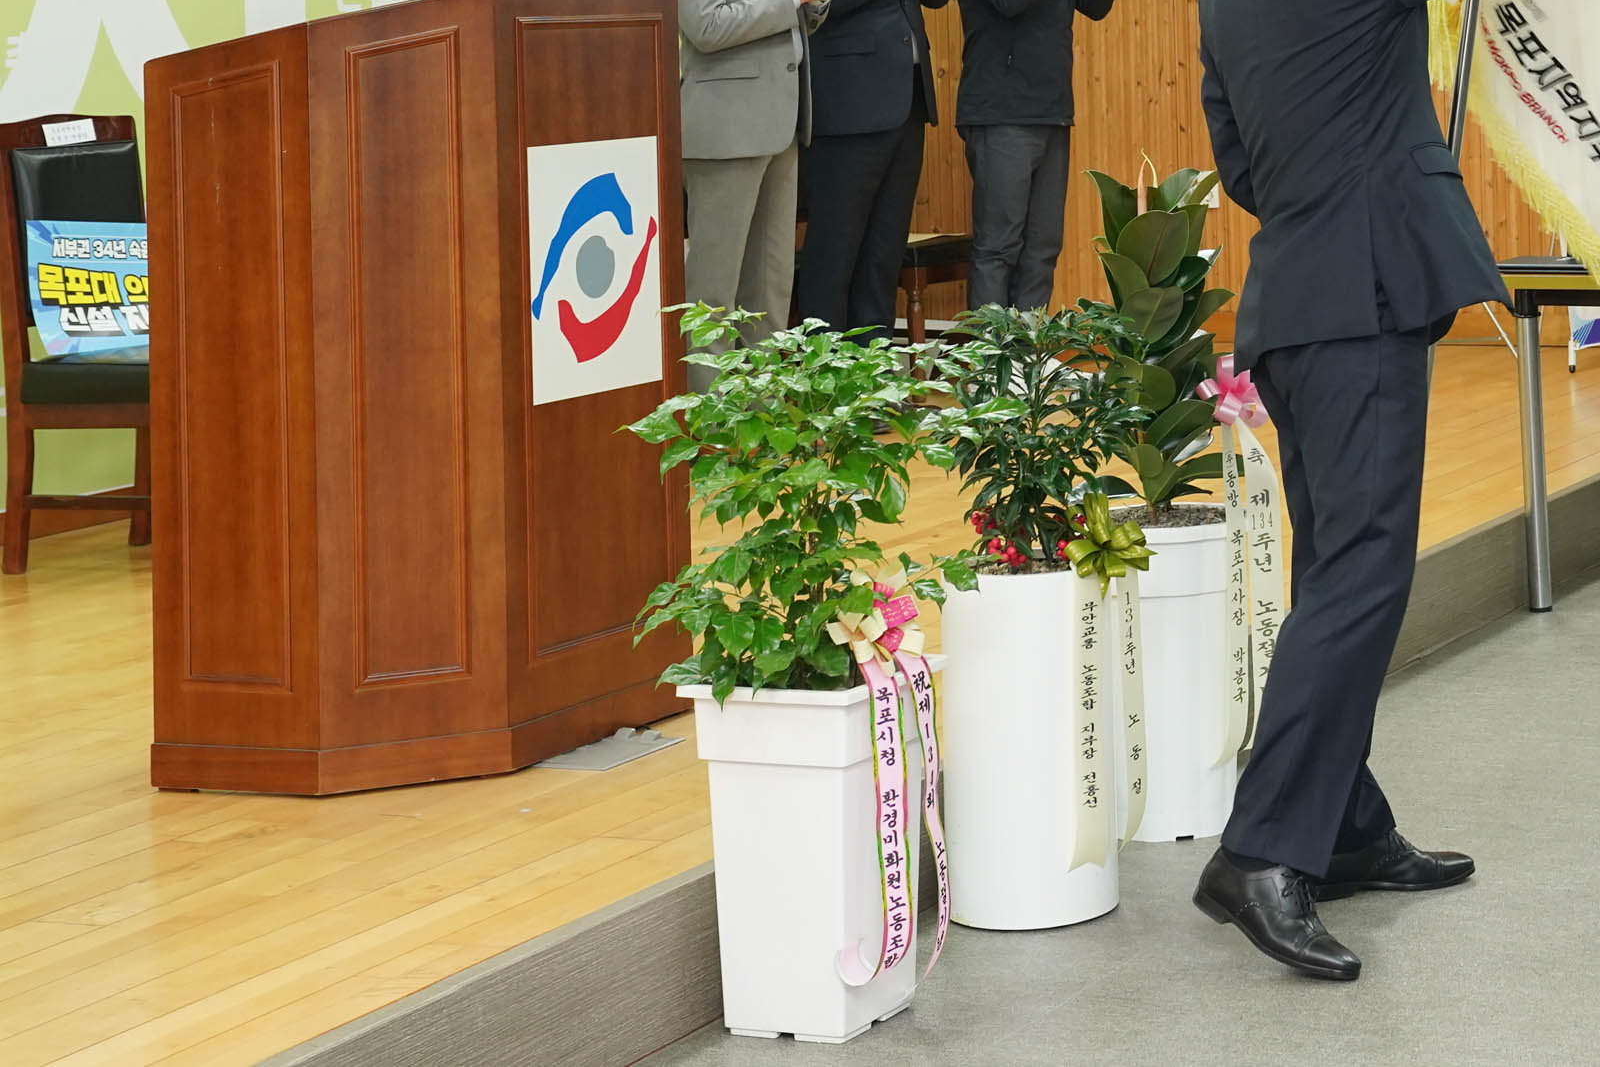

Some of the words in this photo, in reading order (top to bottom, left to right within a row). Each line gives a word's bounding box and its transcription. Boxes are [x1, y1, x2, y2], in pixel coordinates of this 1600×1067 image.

[1518, 91, 1569, 144] BRANCH
[52, 237, 91, 259] 서부권
[93, 238, 127, 260] 34년
[37, 263, 123, 306] 목포대
[60, 305, 122, 334] 신설
[1247, 447, 1265, 465] 축
[875, 686, 898, 767] 목포시청
[1080, 722, 1098, 760] 지부장
